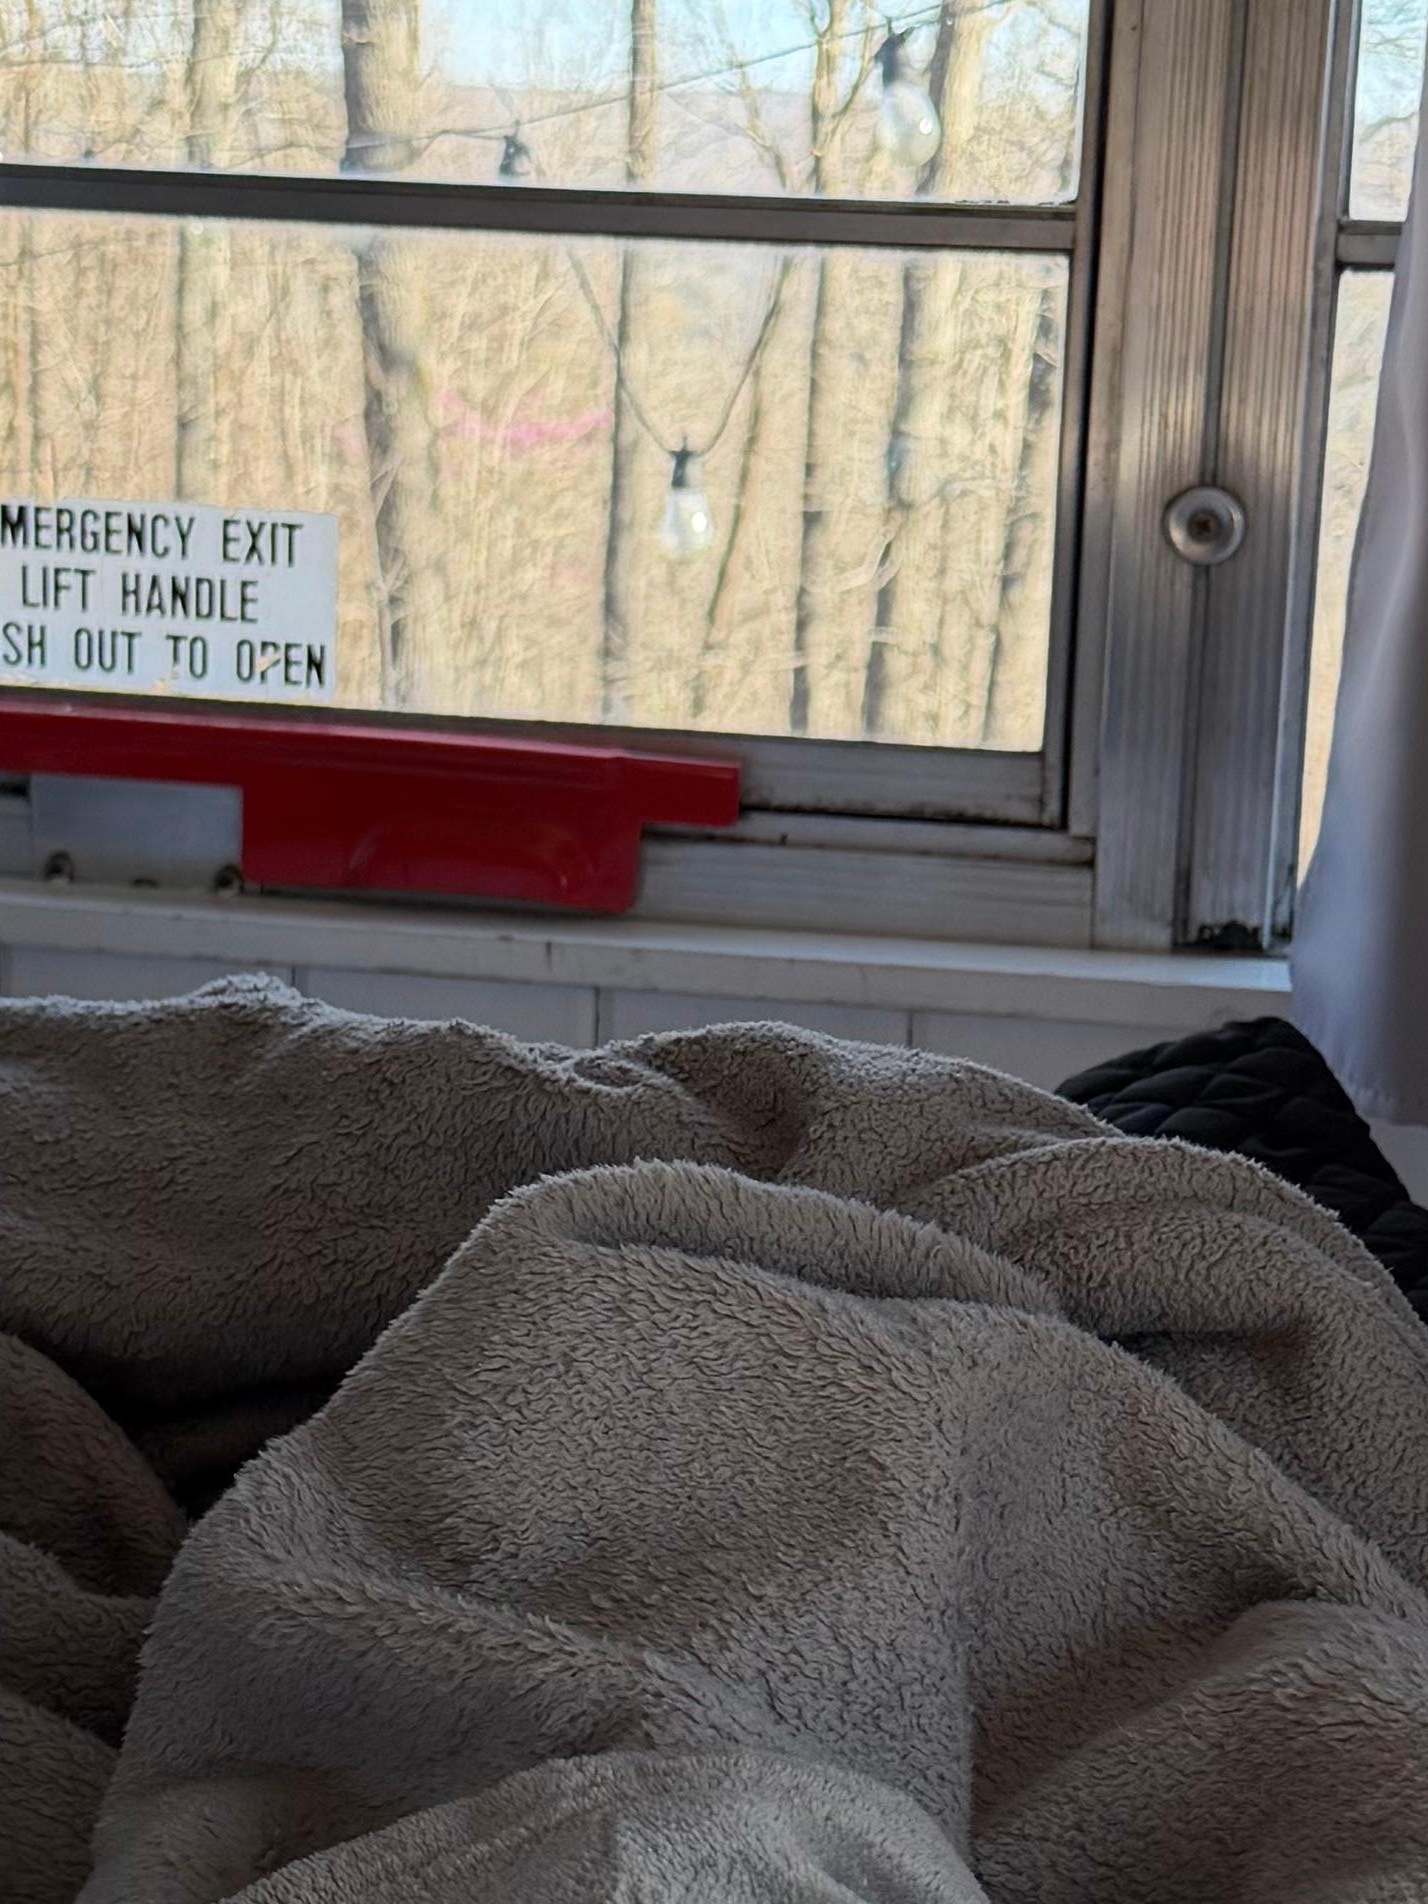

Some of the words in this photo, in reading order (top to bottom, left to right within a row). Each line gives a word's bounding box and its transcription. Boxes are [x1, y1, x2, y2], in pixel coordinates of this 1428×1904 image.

[222, 519, 303, 568] EXIT
[22, 565, 96, 611] LIFT
[121, 572, 259, 622] HANDLE
[74, 627, 142, 673] OUT
[166, 634, 207, 679] TO
[236, 639, 325, 689] OPEN
